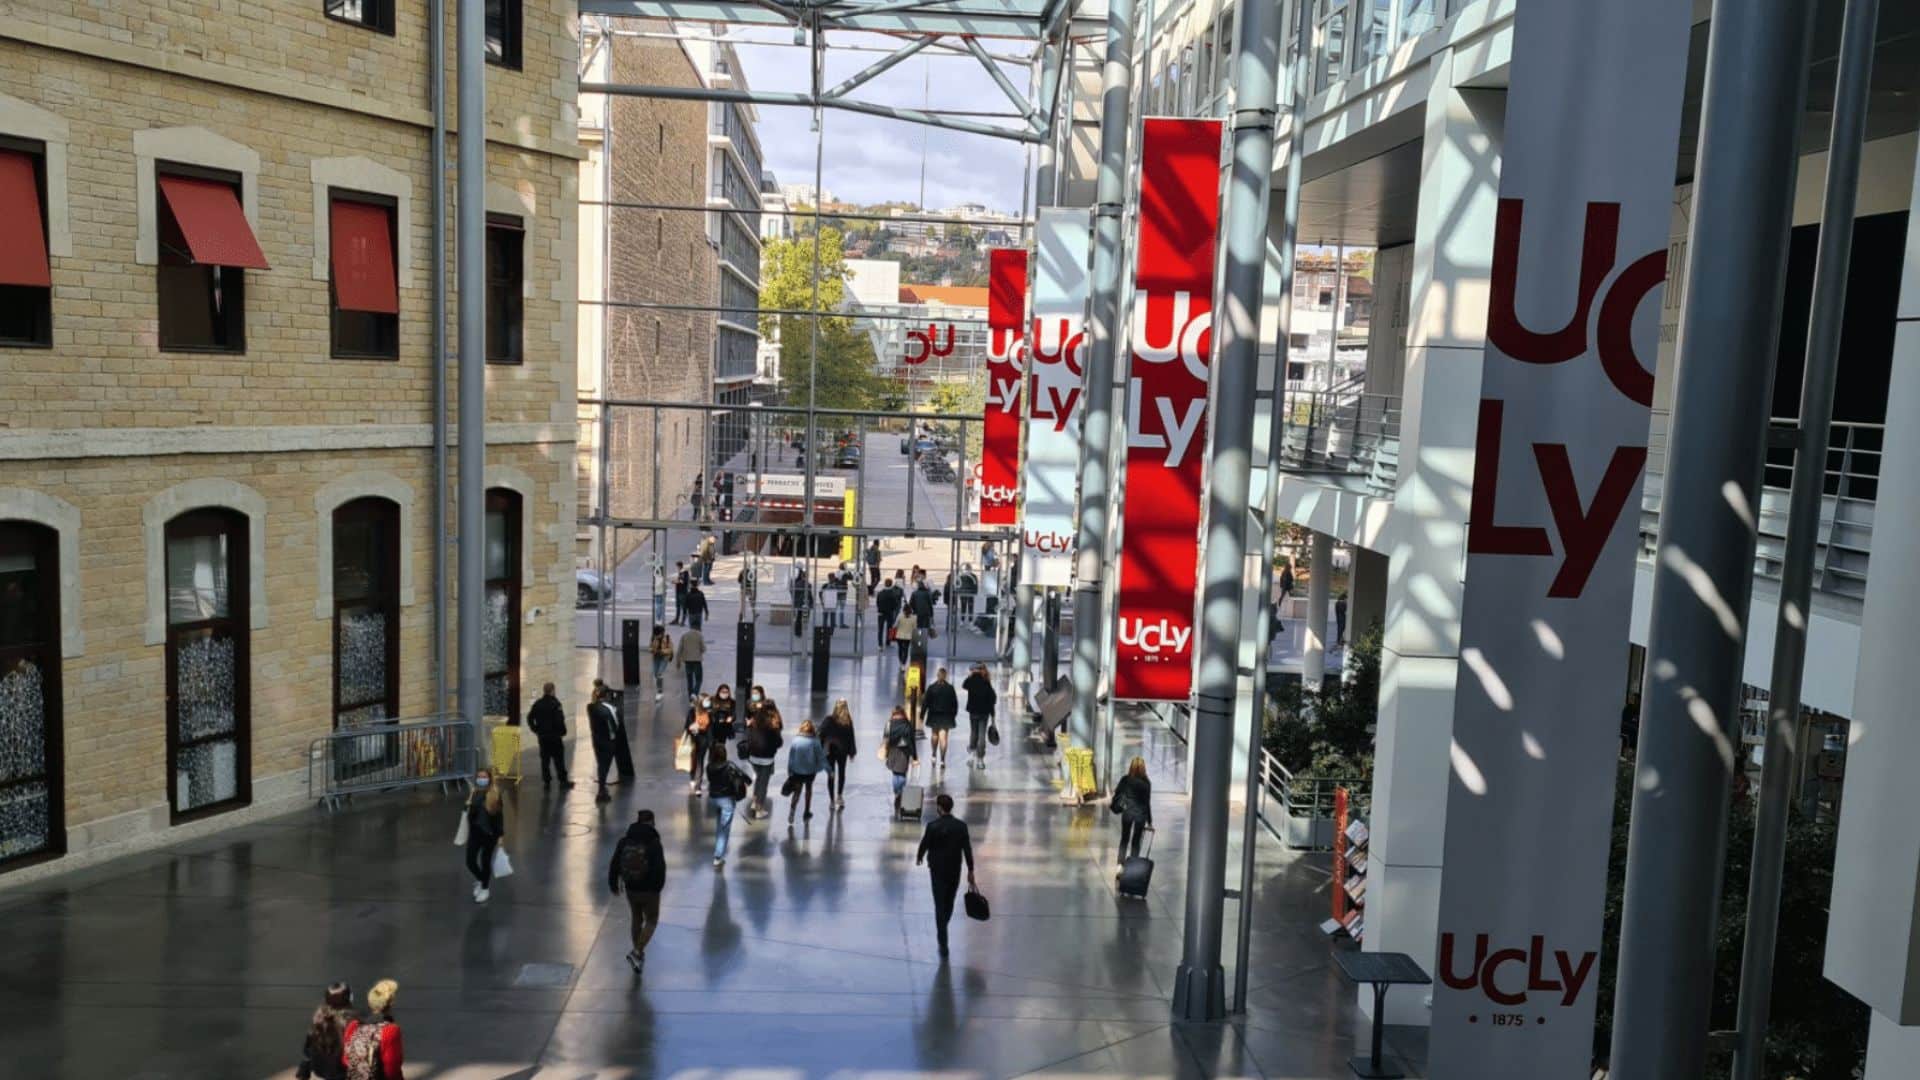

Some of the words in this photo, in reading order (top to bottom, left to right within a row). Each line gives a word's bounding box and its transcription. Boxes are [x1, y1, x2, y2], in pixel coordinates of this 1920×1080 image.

[1030, 374, 1081, 432] Ly
[1128, 377, 1207, 467] Ly
[982, 485, 1016, 502] UCLy
[1467, 398, 1648, 598] Ly
[1025, 530, 1071, 553] UCLy
[1119, 617, 1191, 653] UCLy
[1439, 932, 1598, 1006] UCLy
[1492, 1013, 1524, 1026] 1875
